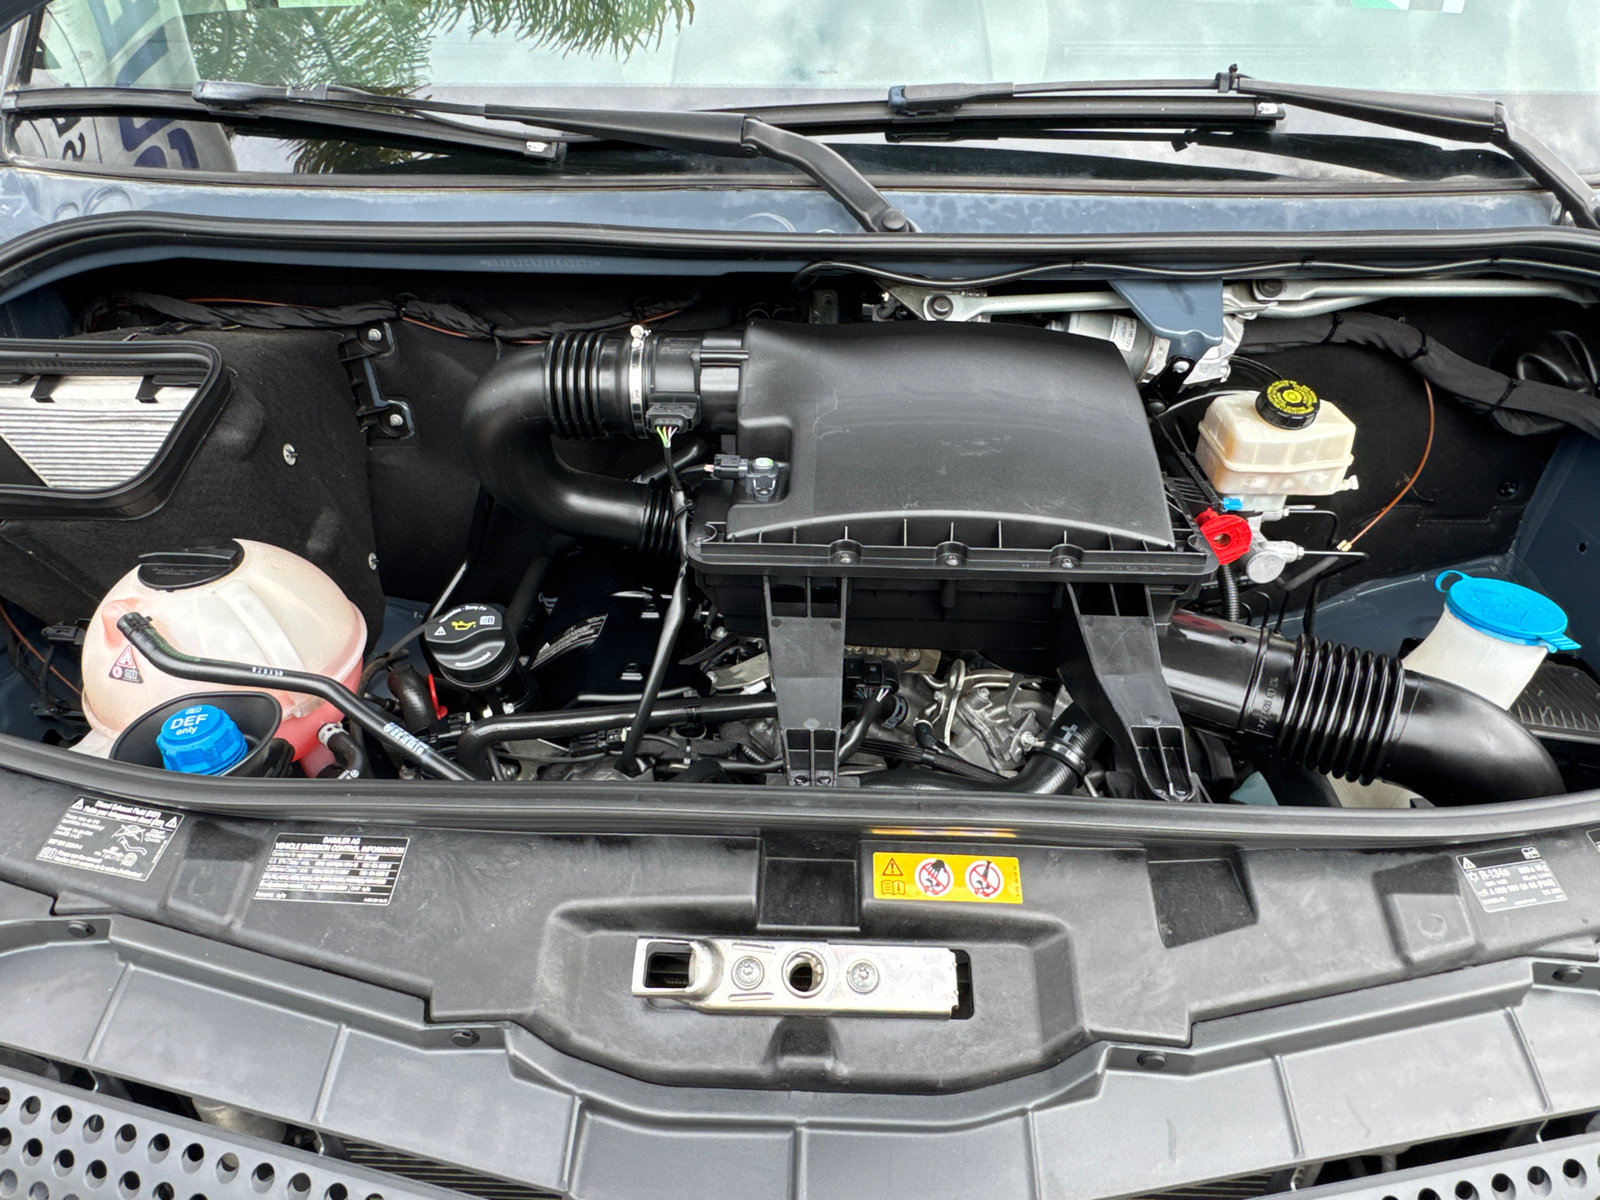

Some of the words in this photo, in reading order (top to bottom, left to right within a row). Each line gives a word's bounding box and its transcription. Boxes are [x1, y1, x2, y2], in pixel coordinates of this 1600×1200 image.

[170, 713, 208, 730] DEF
[175, 726, 198, 736] only
[275, 842, 301, 850] VEHICLE
[301, 843, 331, 851] EMISSION
[331, 844, 360, 852] CONTROL
[1479, 867, 1511, 880] R-134a
